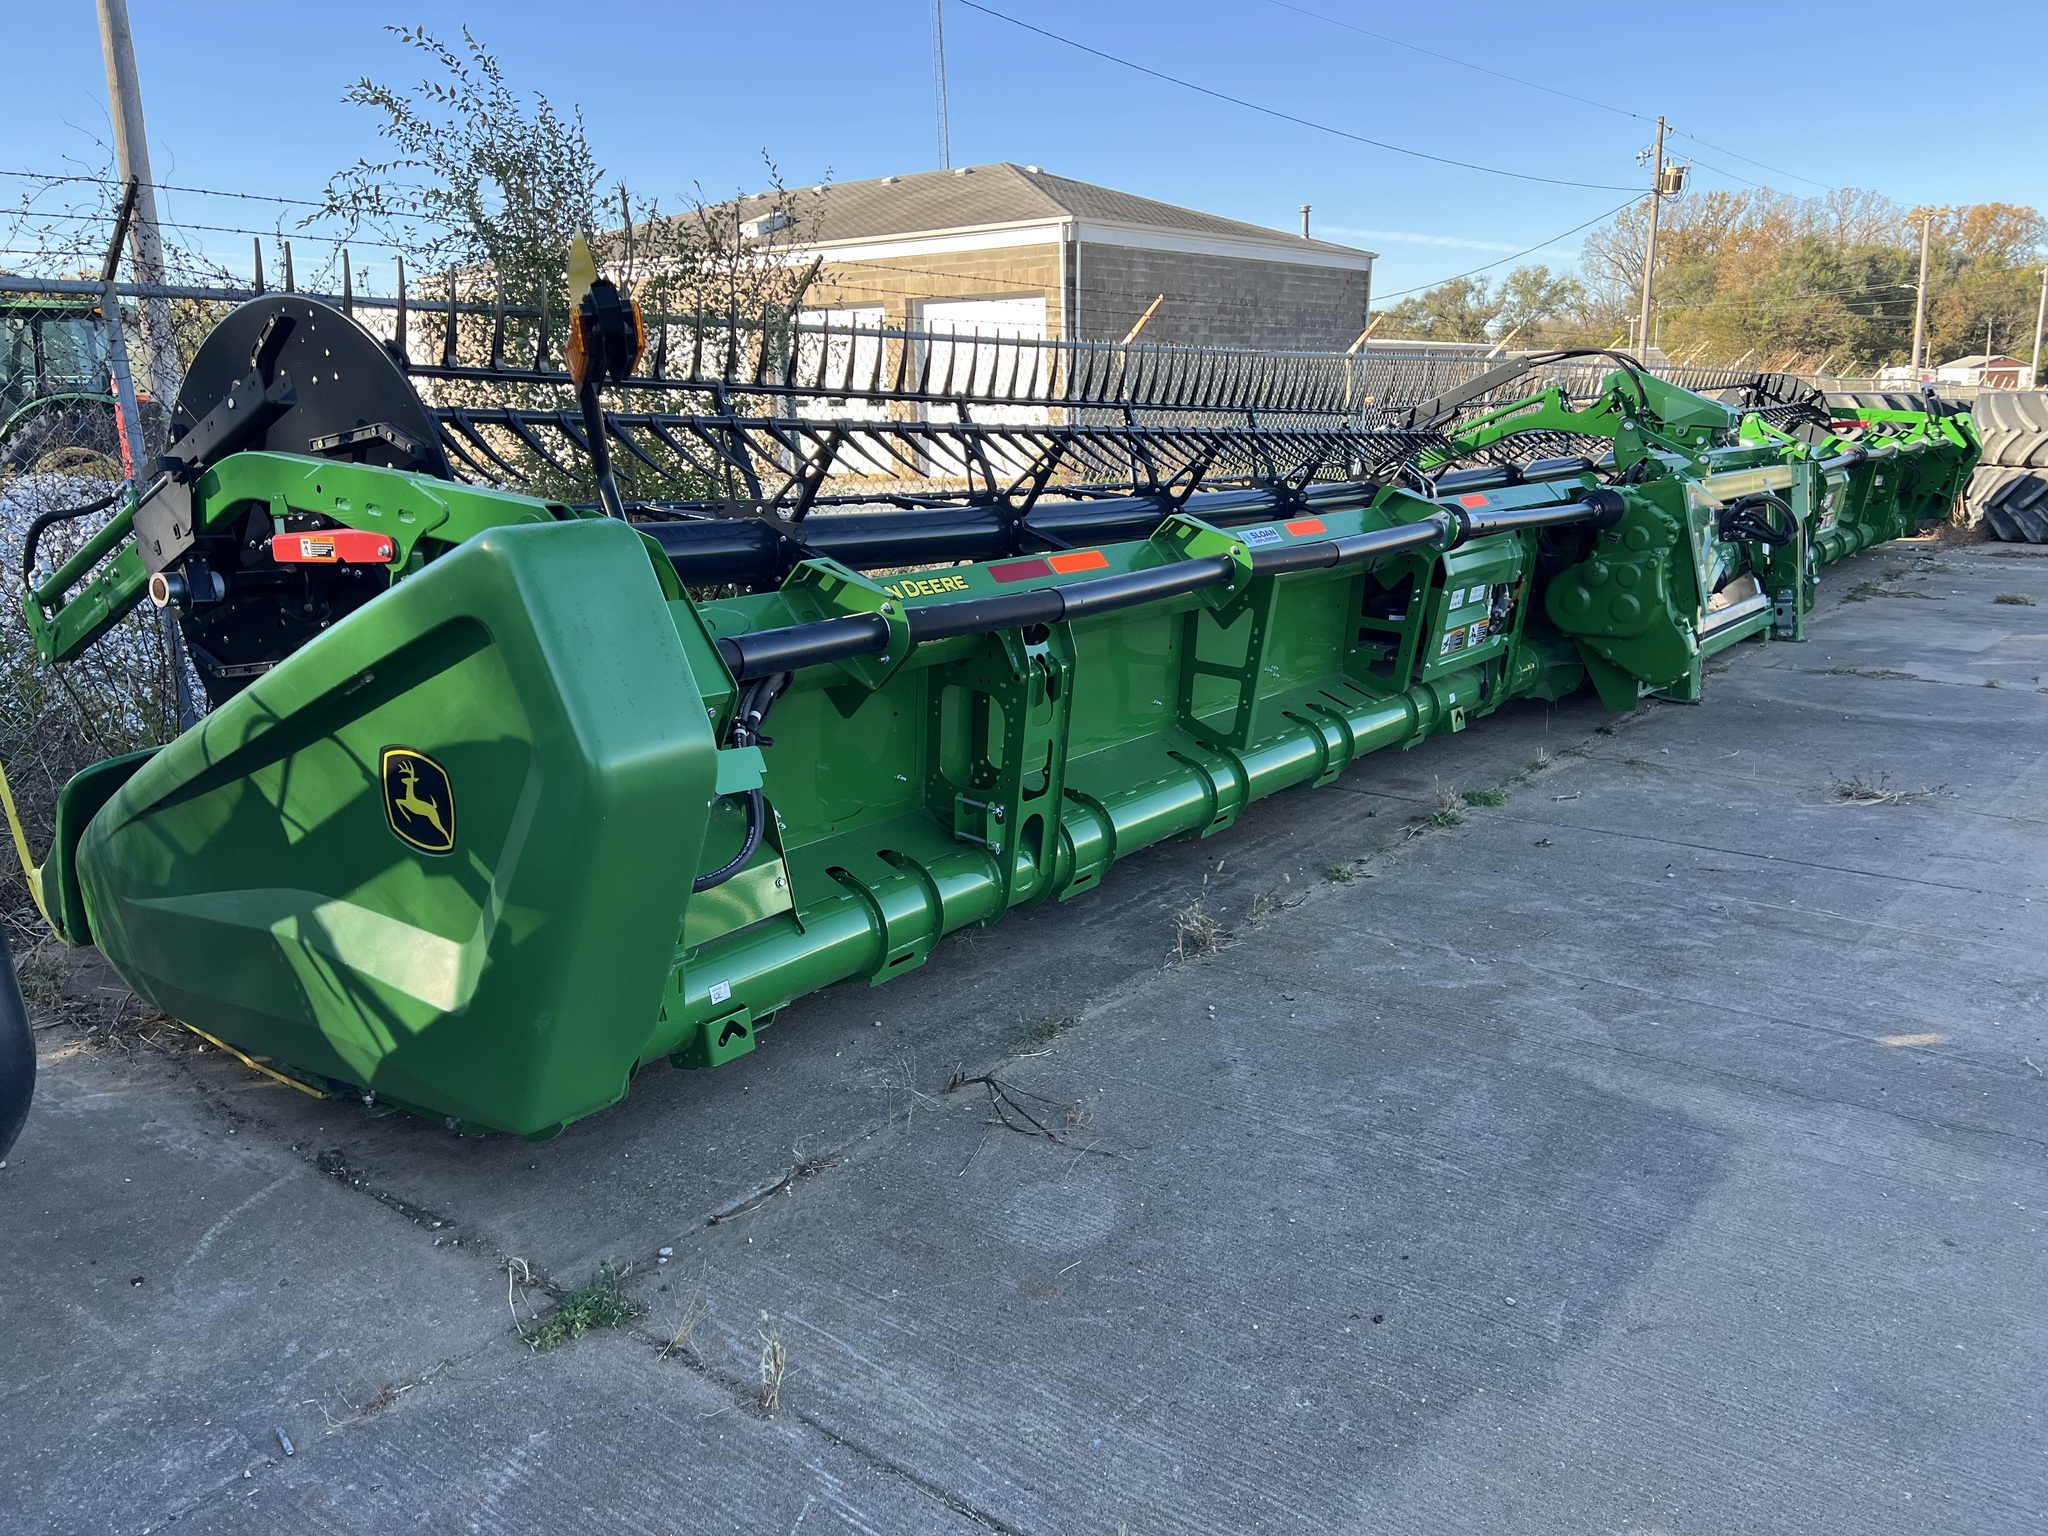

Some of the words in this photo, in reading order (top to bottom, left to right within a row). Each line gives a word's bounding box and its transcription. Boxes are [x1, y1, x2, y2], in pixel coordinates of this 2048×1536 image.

[1250, 529, 1277, 539] SLOAN
[1254, 535, 1279, 544] IMPLEMENT
[900, 575, 970, 598] DEERE
